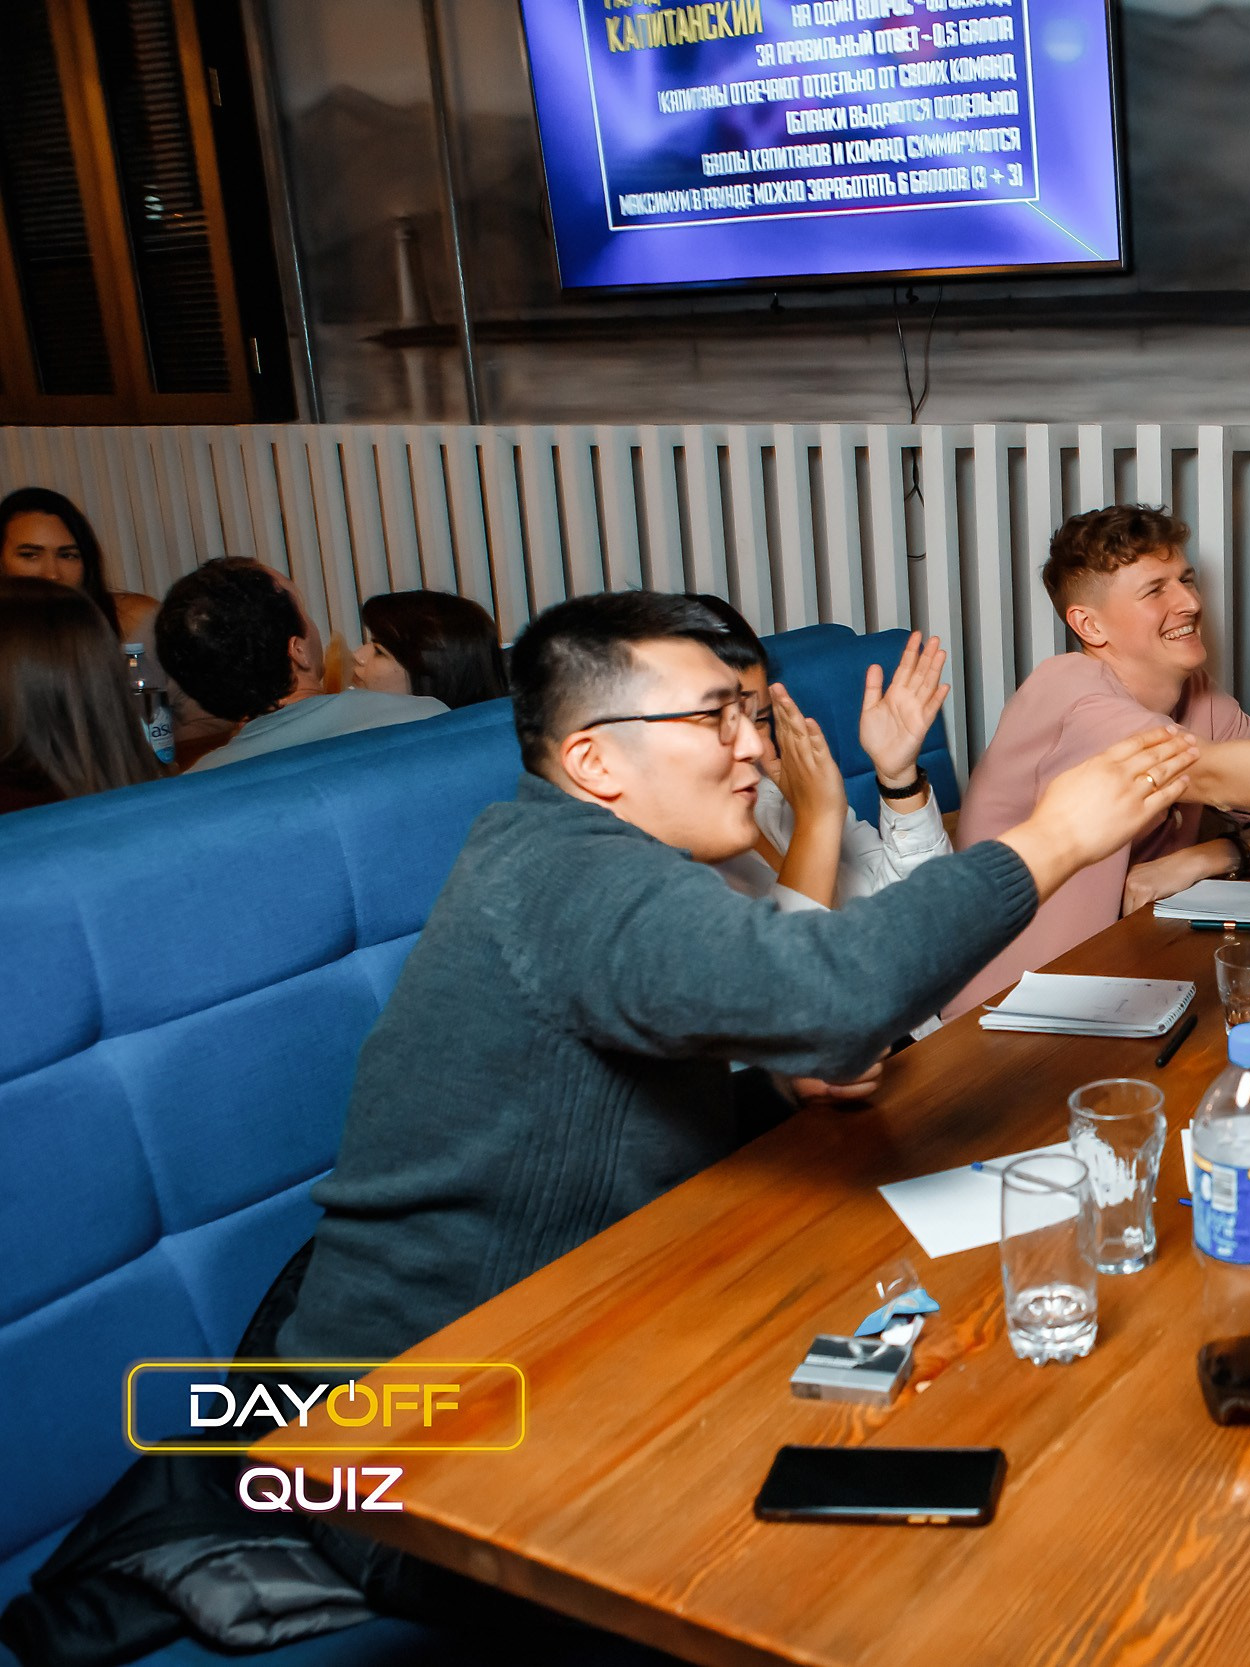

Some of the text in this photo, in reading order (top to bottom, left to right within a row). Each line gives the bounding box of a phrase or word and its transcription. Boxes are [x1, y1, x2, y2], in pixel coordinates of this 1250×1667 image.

[792, 5, 812, 27] НА
[814, 0, 855, 26] ОДИН
[755, 44, 776, 67] ЗА
[777, 30, 874, 65] ПРАВИЛЬНЫЙ
[874, 25, 920, 54] ОТВЕТ
[959, 16, 1014, 46] БАЛЛА
[657, 53, 1017, 114] КАПИТАНЫ ОТВЕЧАЮТ ОТДЕЛЬНО ОТ СВОИХ КОМАНД
[849, 97, 934, 130] ВЫДАЮТСЯ
[701, 126, 1021, 177] БАЛЛЫ КАПИТАНОВ И КОМАНД СУММИРУЮТСЯ
[618, 189, 692, 216] МАКСИМУМ
[691, 188, 701, 211] В
[700, 183, 754, 210] РАУНДЕ
[752, 179, 807, 205] МОЖНО
[806, 172, 897, 202] ЗАРАБОТАТЬ
[897, 171, 910, 195] 6
[909, 166, 971, 194] БАЛЛОВ
[152, 724, 172, 738] as
